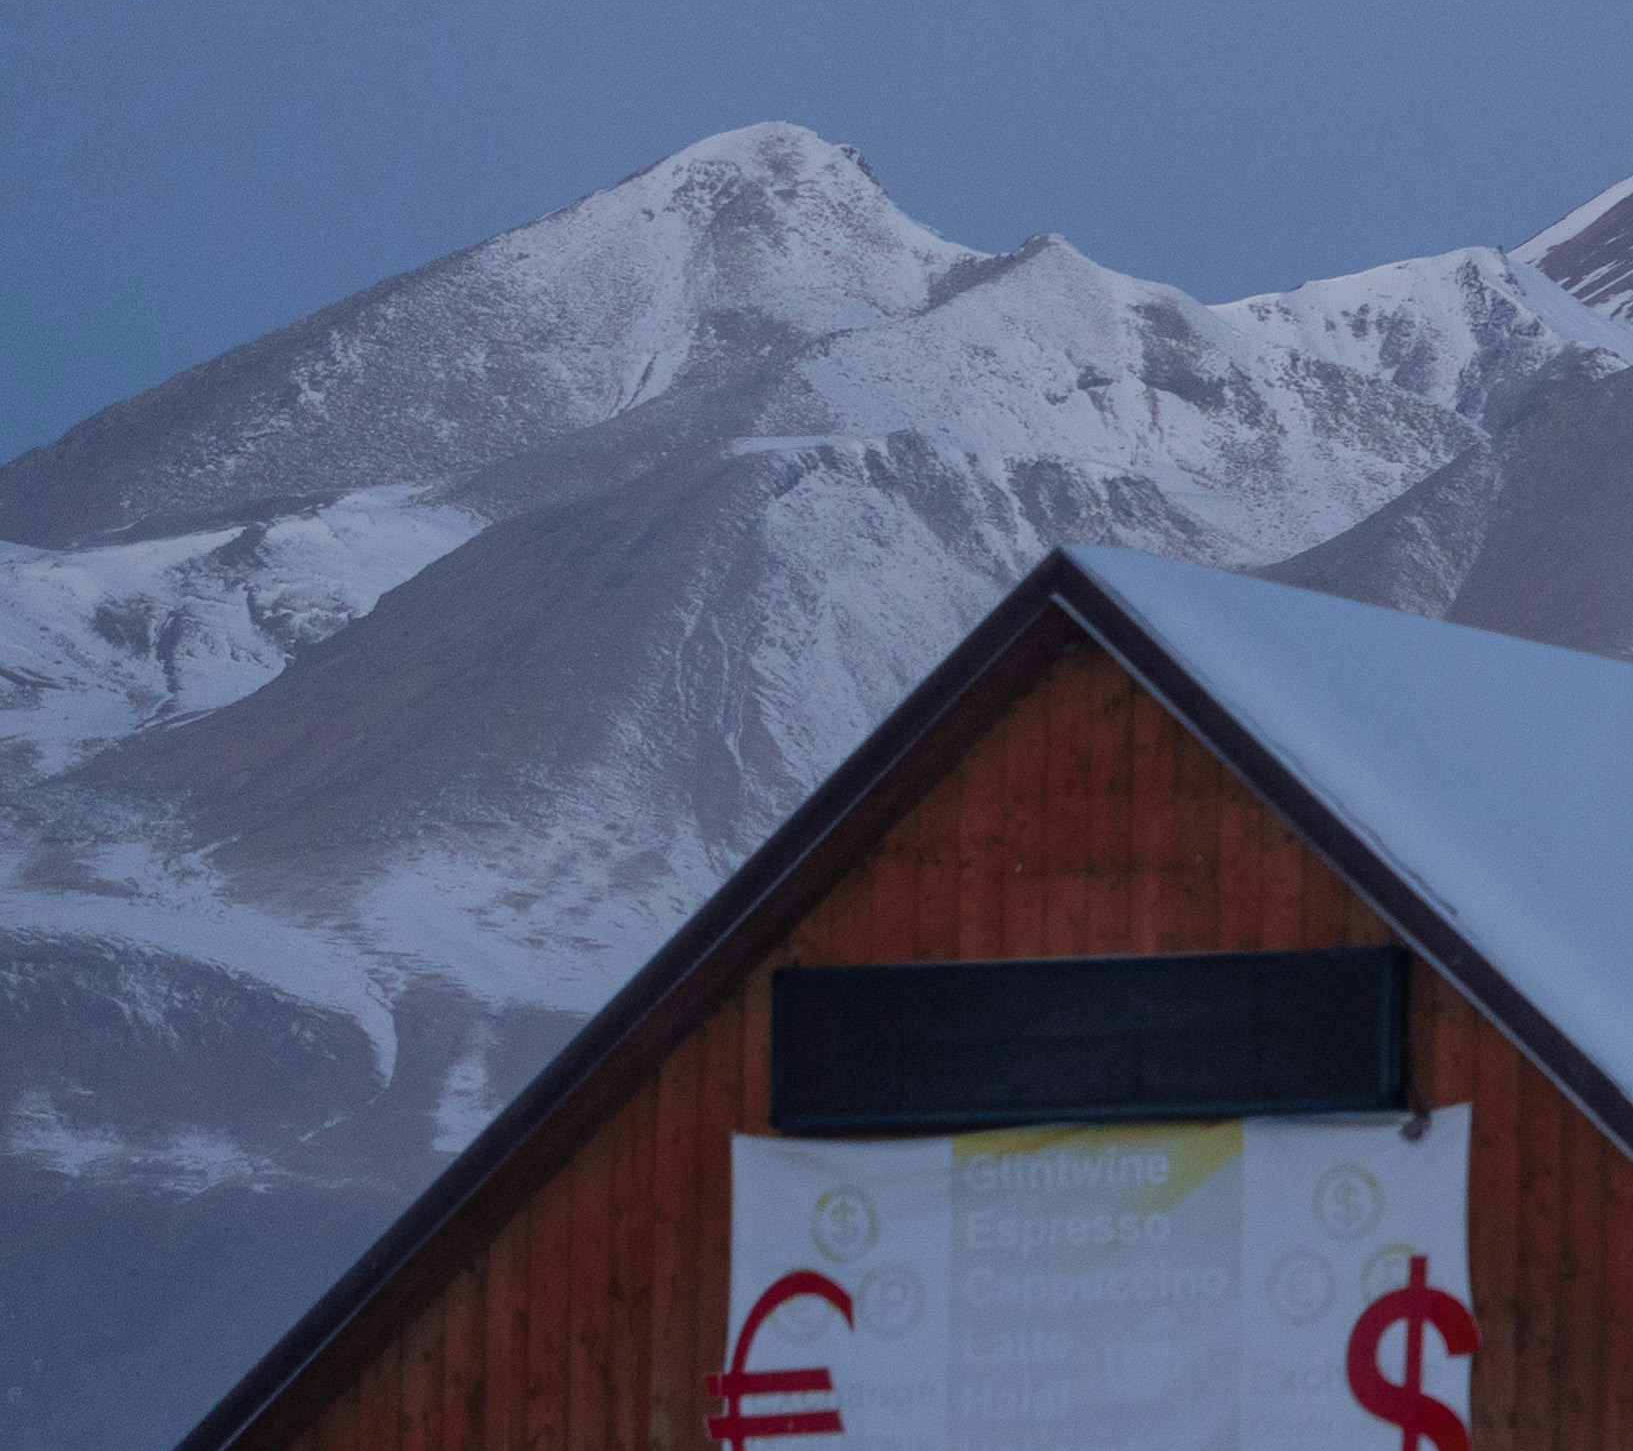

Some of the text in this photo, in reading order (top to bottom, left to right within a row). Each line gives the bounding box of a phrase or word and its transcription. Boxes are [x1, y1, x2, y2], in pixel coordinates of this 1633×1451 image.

[963, 1145, 1171, 1191] Glintwine
[964, 1209, 1171, 1258] Espresso
[962, 1325, 1072, 1363] Latte
